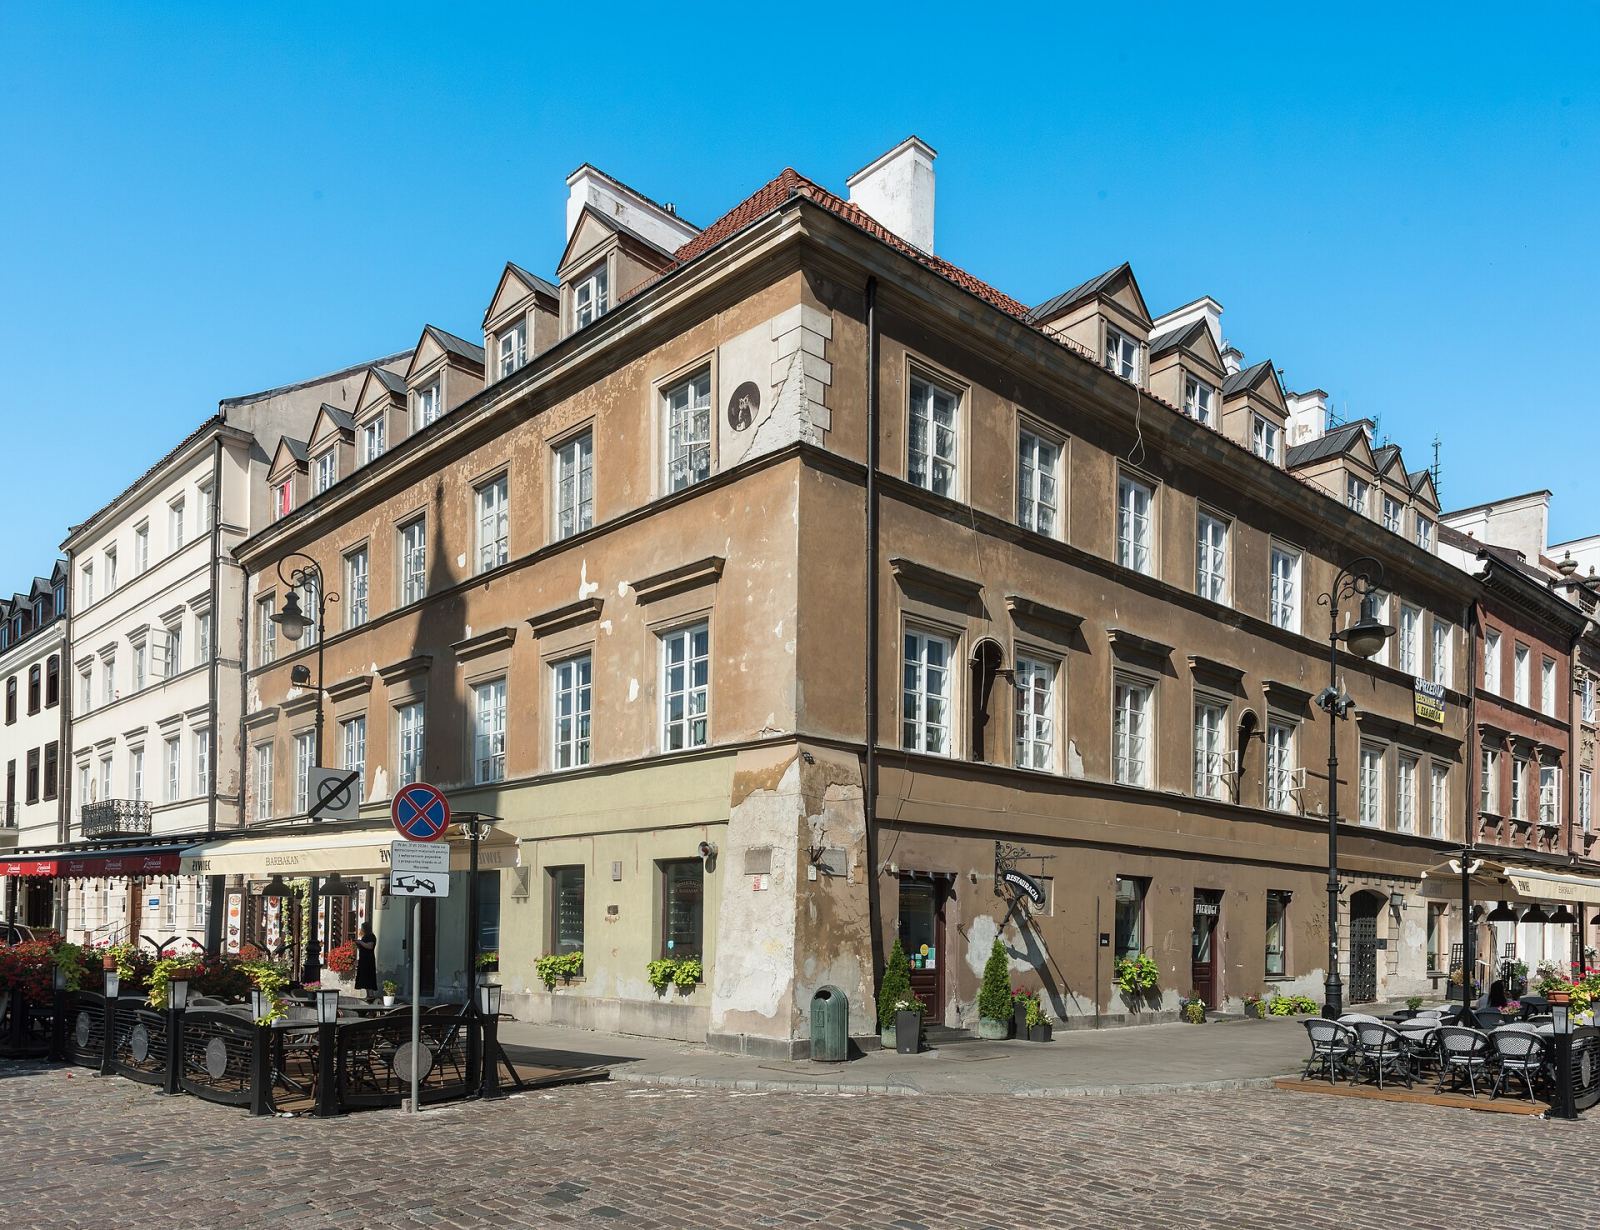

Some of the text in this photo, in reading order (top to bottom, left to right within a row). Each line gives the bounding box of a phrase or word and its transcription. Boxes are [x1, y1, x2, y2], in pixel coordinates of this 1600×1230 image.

[192, 859, 211, 871] ŻYWIEC
[265, 856, 299, 867] BARBAKAN
[1005, 873, 1039, 901] RESTAURACJA
[1195, 904, 1217, 915] PIEROGI
